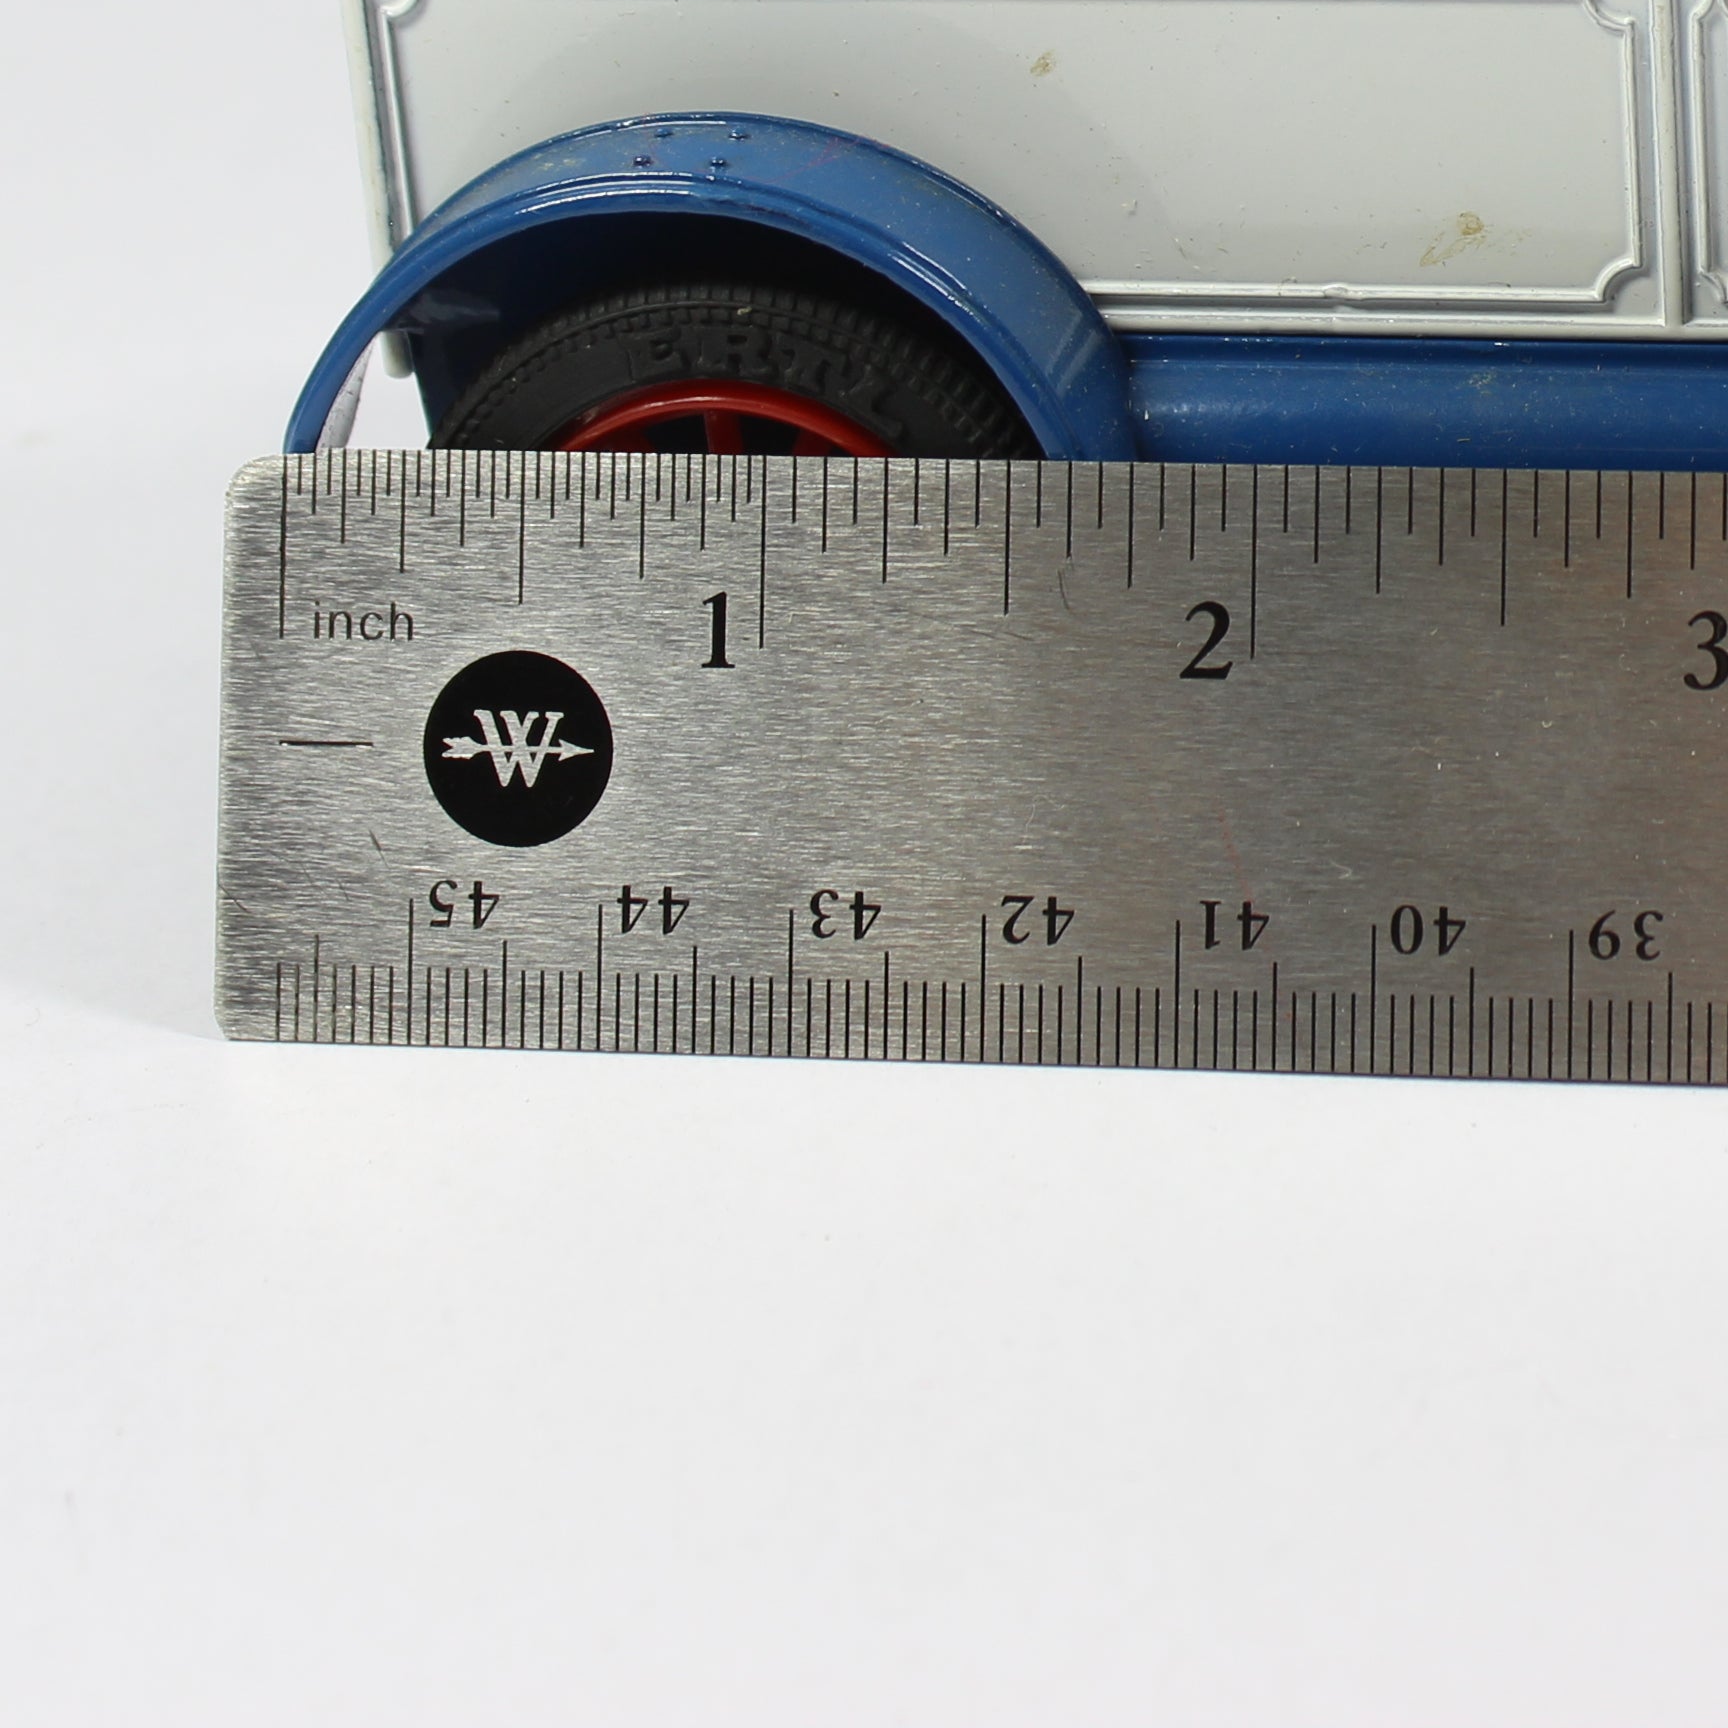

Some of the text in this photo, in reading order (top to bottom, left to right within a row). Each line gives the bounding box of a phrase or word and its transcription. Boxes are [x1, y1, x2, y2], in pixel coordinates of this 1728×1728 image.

[620, 322, 905, 439] ERTL
[312, 600, 415, 642] inch
[700, 591, 736, 669] 1
[1178, 600, 1234, 680] 2
[428, 880, 500, 930] 45
[616, 885, 691, 935] 44
[809, 889, 882, 941] 43
[1001, 895, 1076, 946] 42
[1199, 900, 1271, 951] 41
[1390, 905, 1467, 956] 40
[1587, 910, 1665, 961] 39
